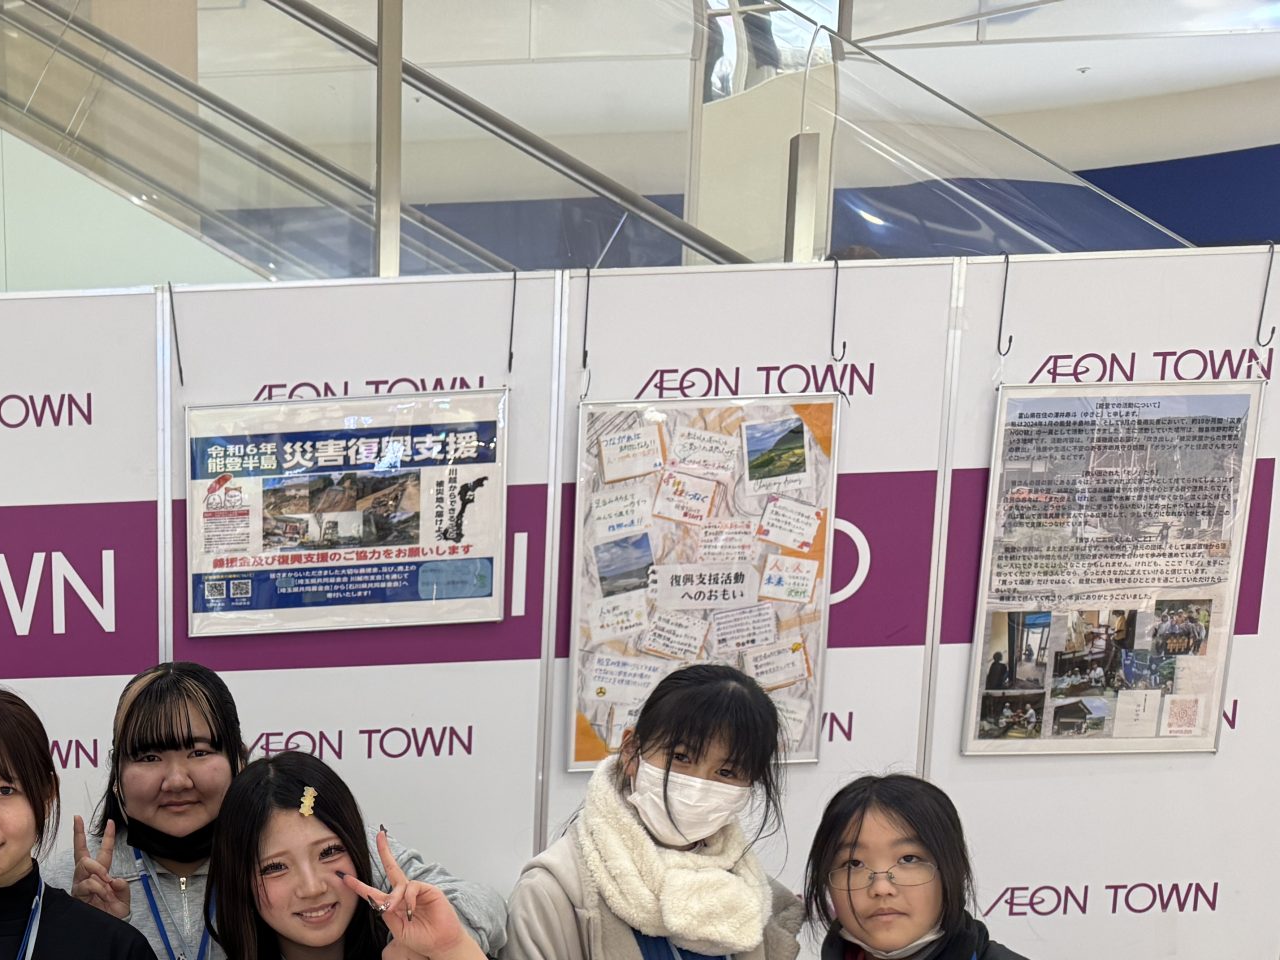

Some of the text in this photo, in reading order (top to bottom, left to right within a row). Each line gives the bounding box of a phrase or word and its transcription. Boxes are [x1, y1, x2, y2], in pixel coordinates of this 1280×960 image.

[757, 363, 875, 396] TOWN
[1153, 348, 1274, 381] TOWN
[207, 442, 277, 458] 令和6年
[207, 455, 277, 473] 能登半島
[282, 431, 479, 470] 災害復興支援
[670, 573, 745, 587] 復興支援活動
[681, 589, 744, 602] へのおもい
[360, 725, 473, 759] TOWN
[1105, 882, 1218, 912] TOWN
